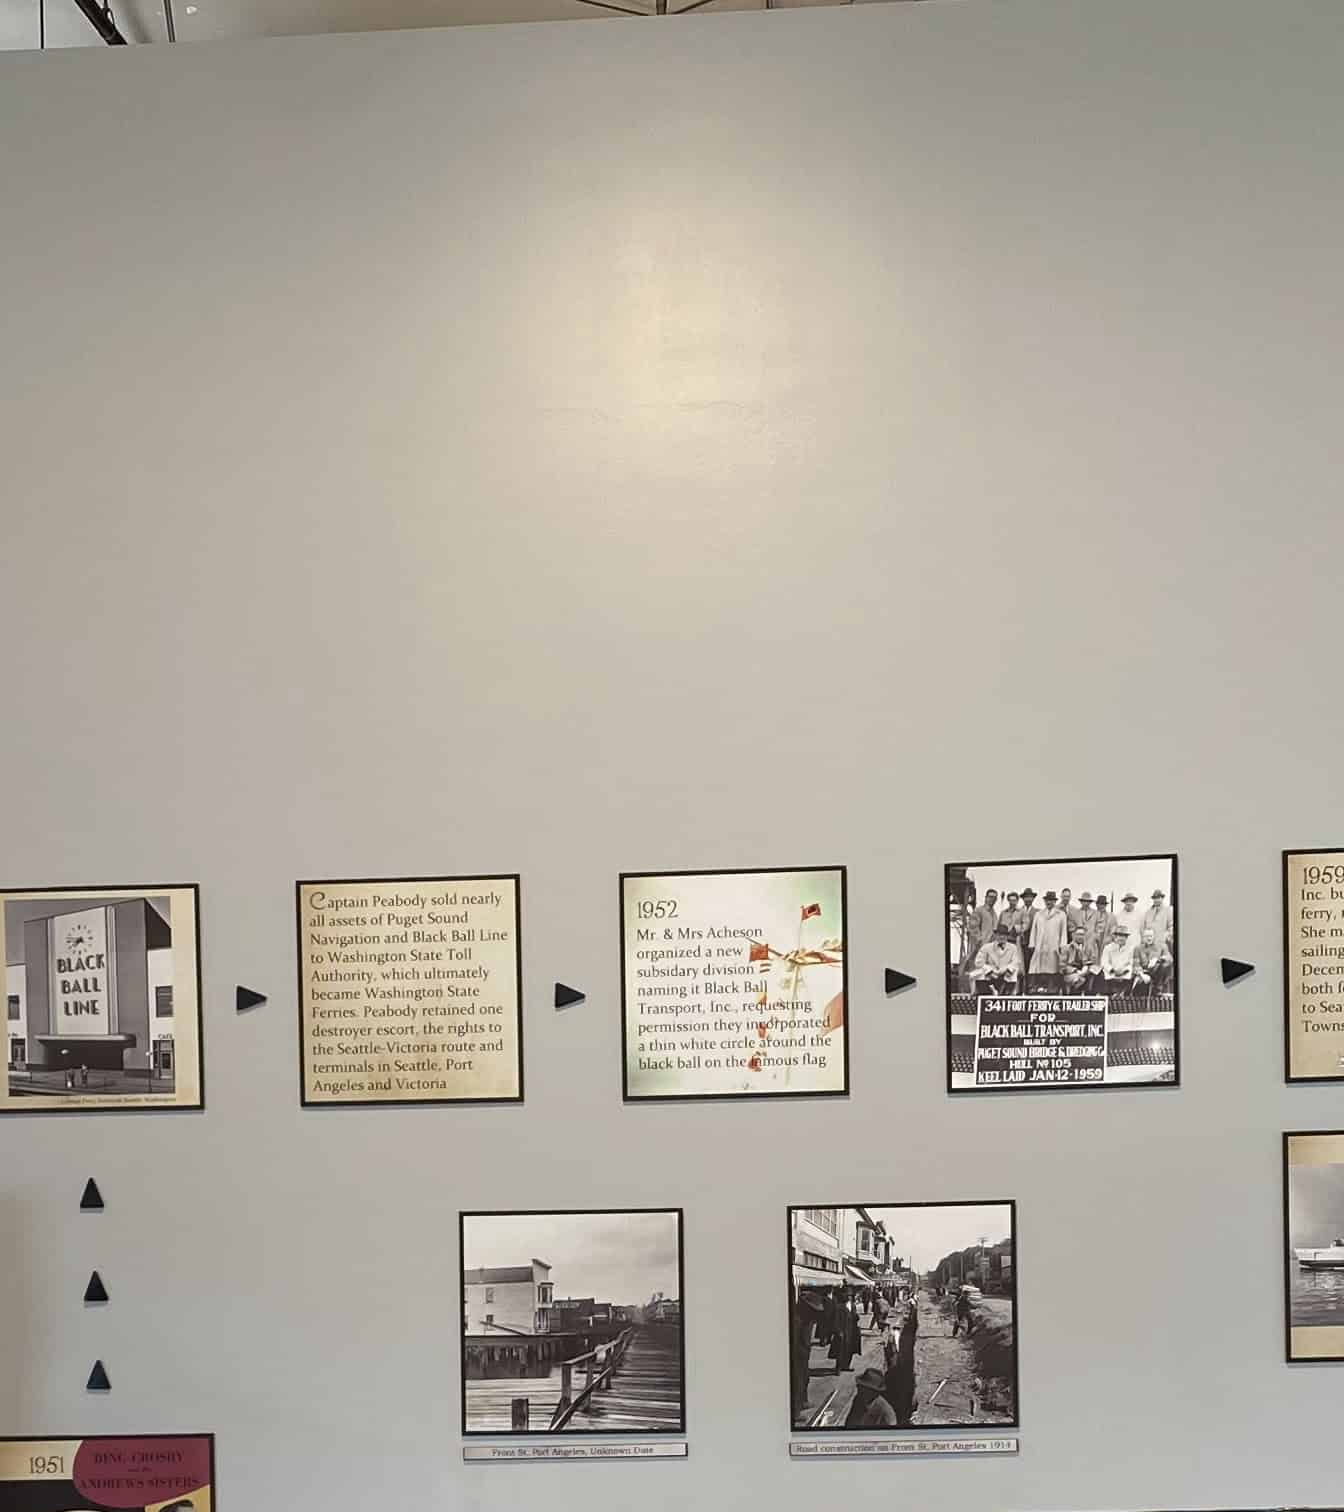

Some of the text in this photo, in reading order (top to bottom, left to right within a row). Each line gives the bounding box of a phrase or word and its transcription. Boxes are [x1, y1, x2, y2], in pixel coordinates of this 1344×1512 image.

[309, 890, 502, 912] Captain Peabody sold nearly
[637, 899, 678, 919] 1952
[309, 910, 468, 928] all assets of Puget Sound
[1300, 905, 1337, 922] ferry,
[309, 928, 508, 949] Navigation and Black Ball Line
[663, 928, 672, 940] &
[705, 925, 762, 938] Acheson
[1300, 925, 1325, 938] She
[310, 947, 471, 966] to Washington State Toll
[636, 945, 743, 962] organized a new
[57, 954, 105, 974] BLACK
[636, 962, 753, 981] subsidary division
[380, 967, 419, 980] which
[423, 965, 489, 983] ultimately
[61, 977, 101, 994] BALL
[637, 980, 767, 999] naming it Black Ball
[64, 1000, 100, 1016] LINE
[742, 997, 812, 1015] requesting
[984, 1000, 1006, 1012] 341
[1030, 1013, 1056, 1023] FOR
[980, 1024, 1009, 1039] BLACK
[1010, 1024, 1033, 1038] BALL
[29, 1455, 64, 1474] 1951
